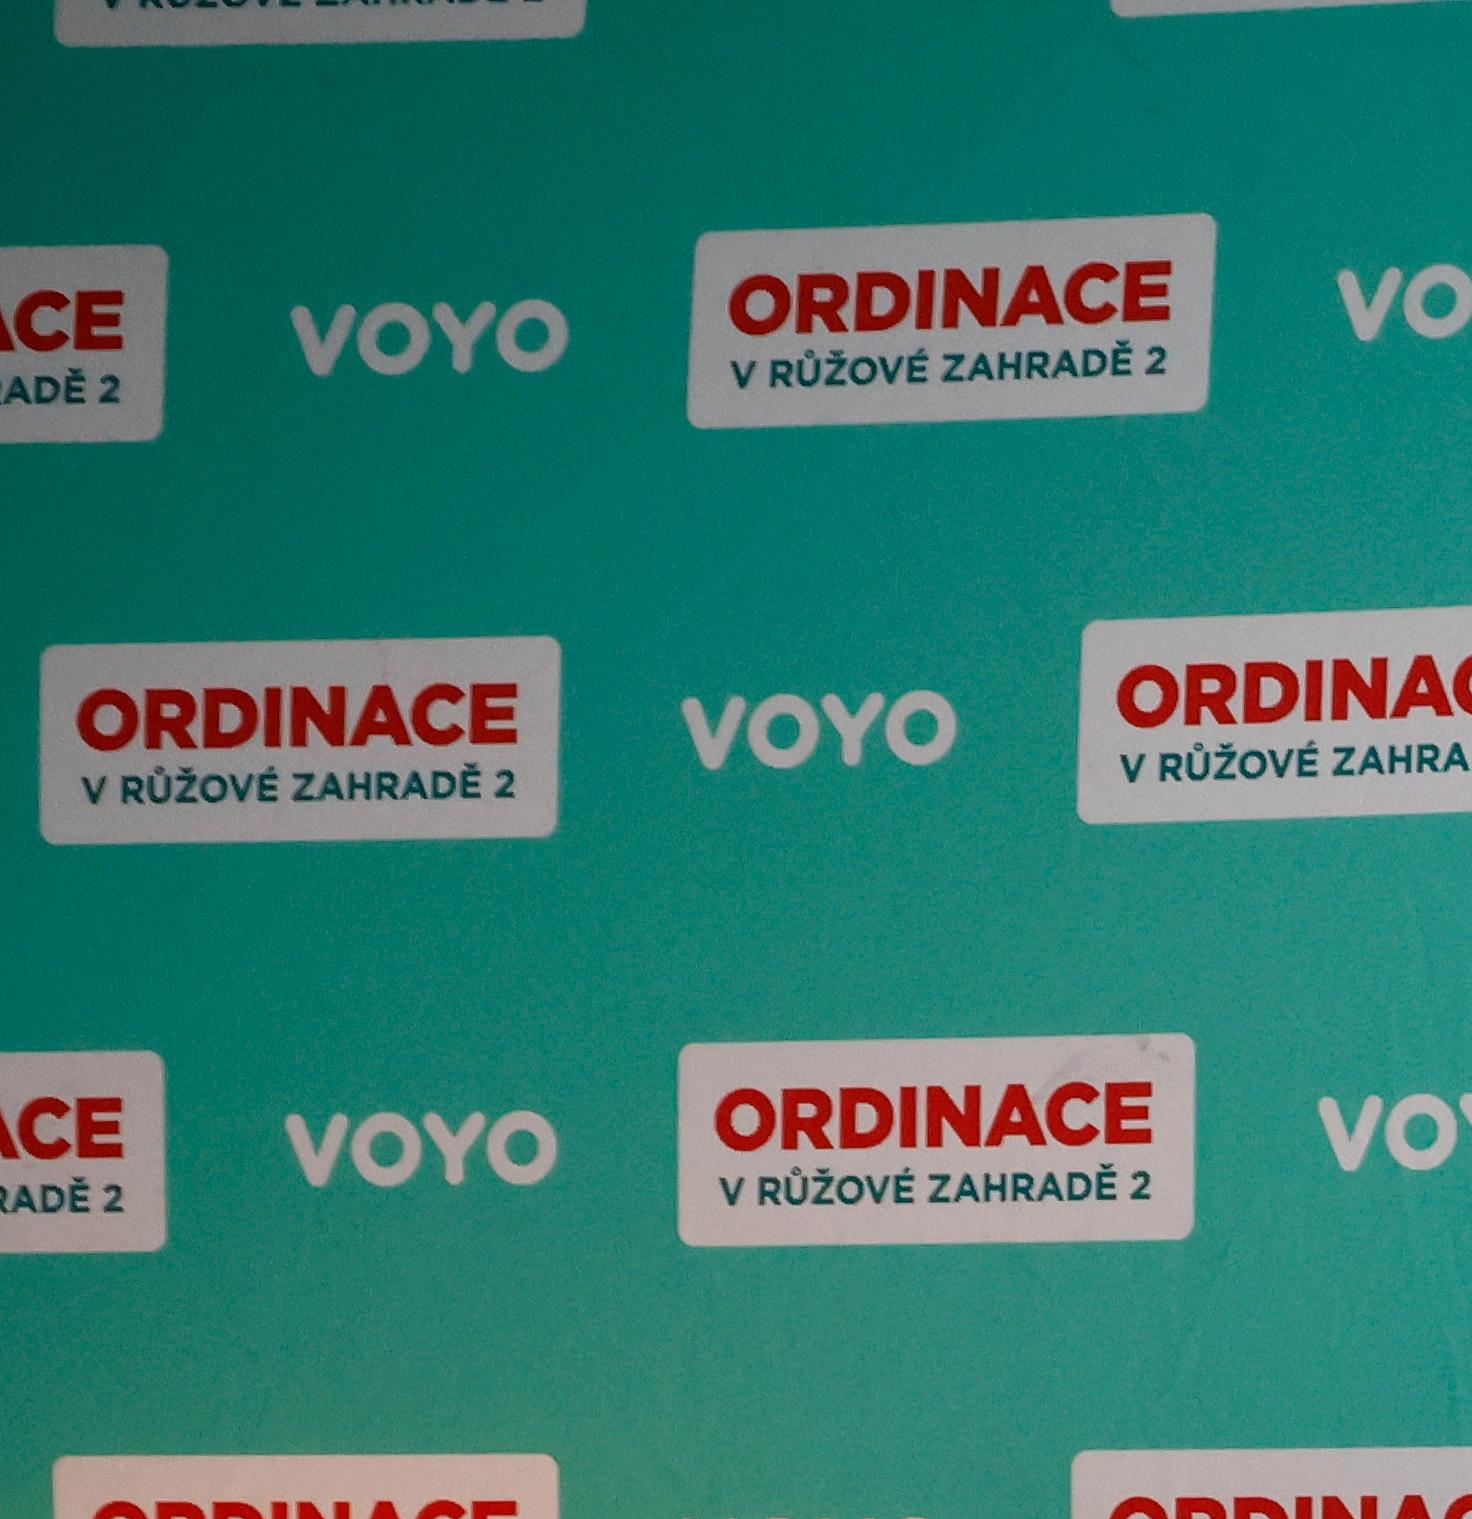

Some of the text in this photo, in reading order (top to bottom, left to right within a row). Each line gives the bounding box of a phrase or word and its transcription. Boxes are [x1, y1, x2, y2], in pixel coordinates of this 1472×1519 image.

[730, 261, 1171, 335] ORDINACE
[291, 299, 569, 376] VOYO
[730, 338, 1168, 391] V RŮŽOVÉ ZAHRADĚ 2
[77, 684, 517, 751] ORDINACE
[681, 690, 958, 771] VOYO
[81, 762, 516, 806] V RŮŽOVÉ ZAHRADĚ 2
[1120, 752, 1146, 784] V
[1158, 739, 1320, 783] RŮŽOVÉ
[285, 1110, 559, 1188] VOYO
[716, 1082, 1152, 1151] ORDINACE
[719, 1162, 1152, 1207] V RŮŽOVÉ ZAHRADĚ 2
